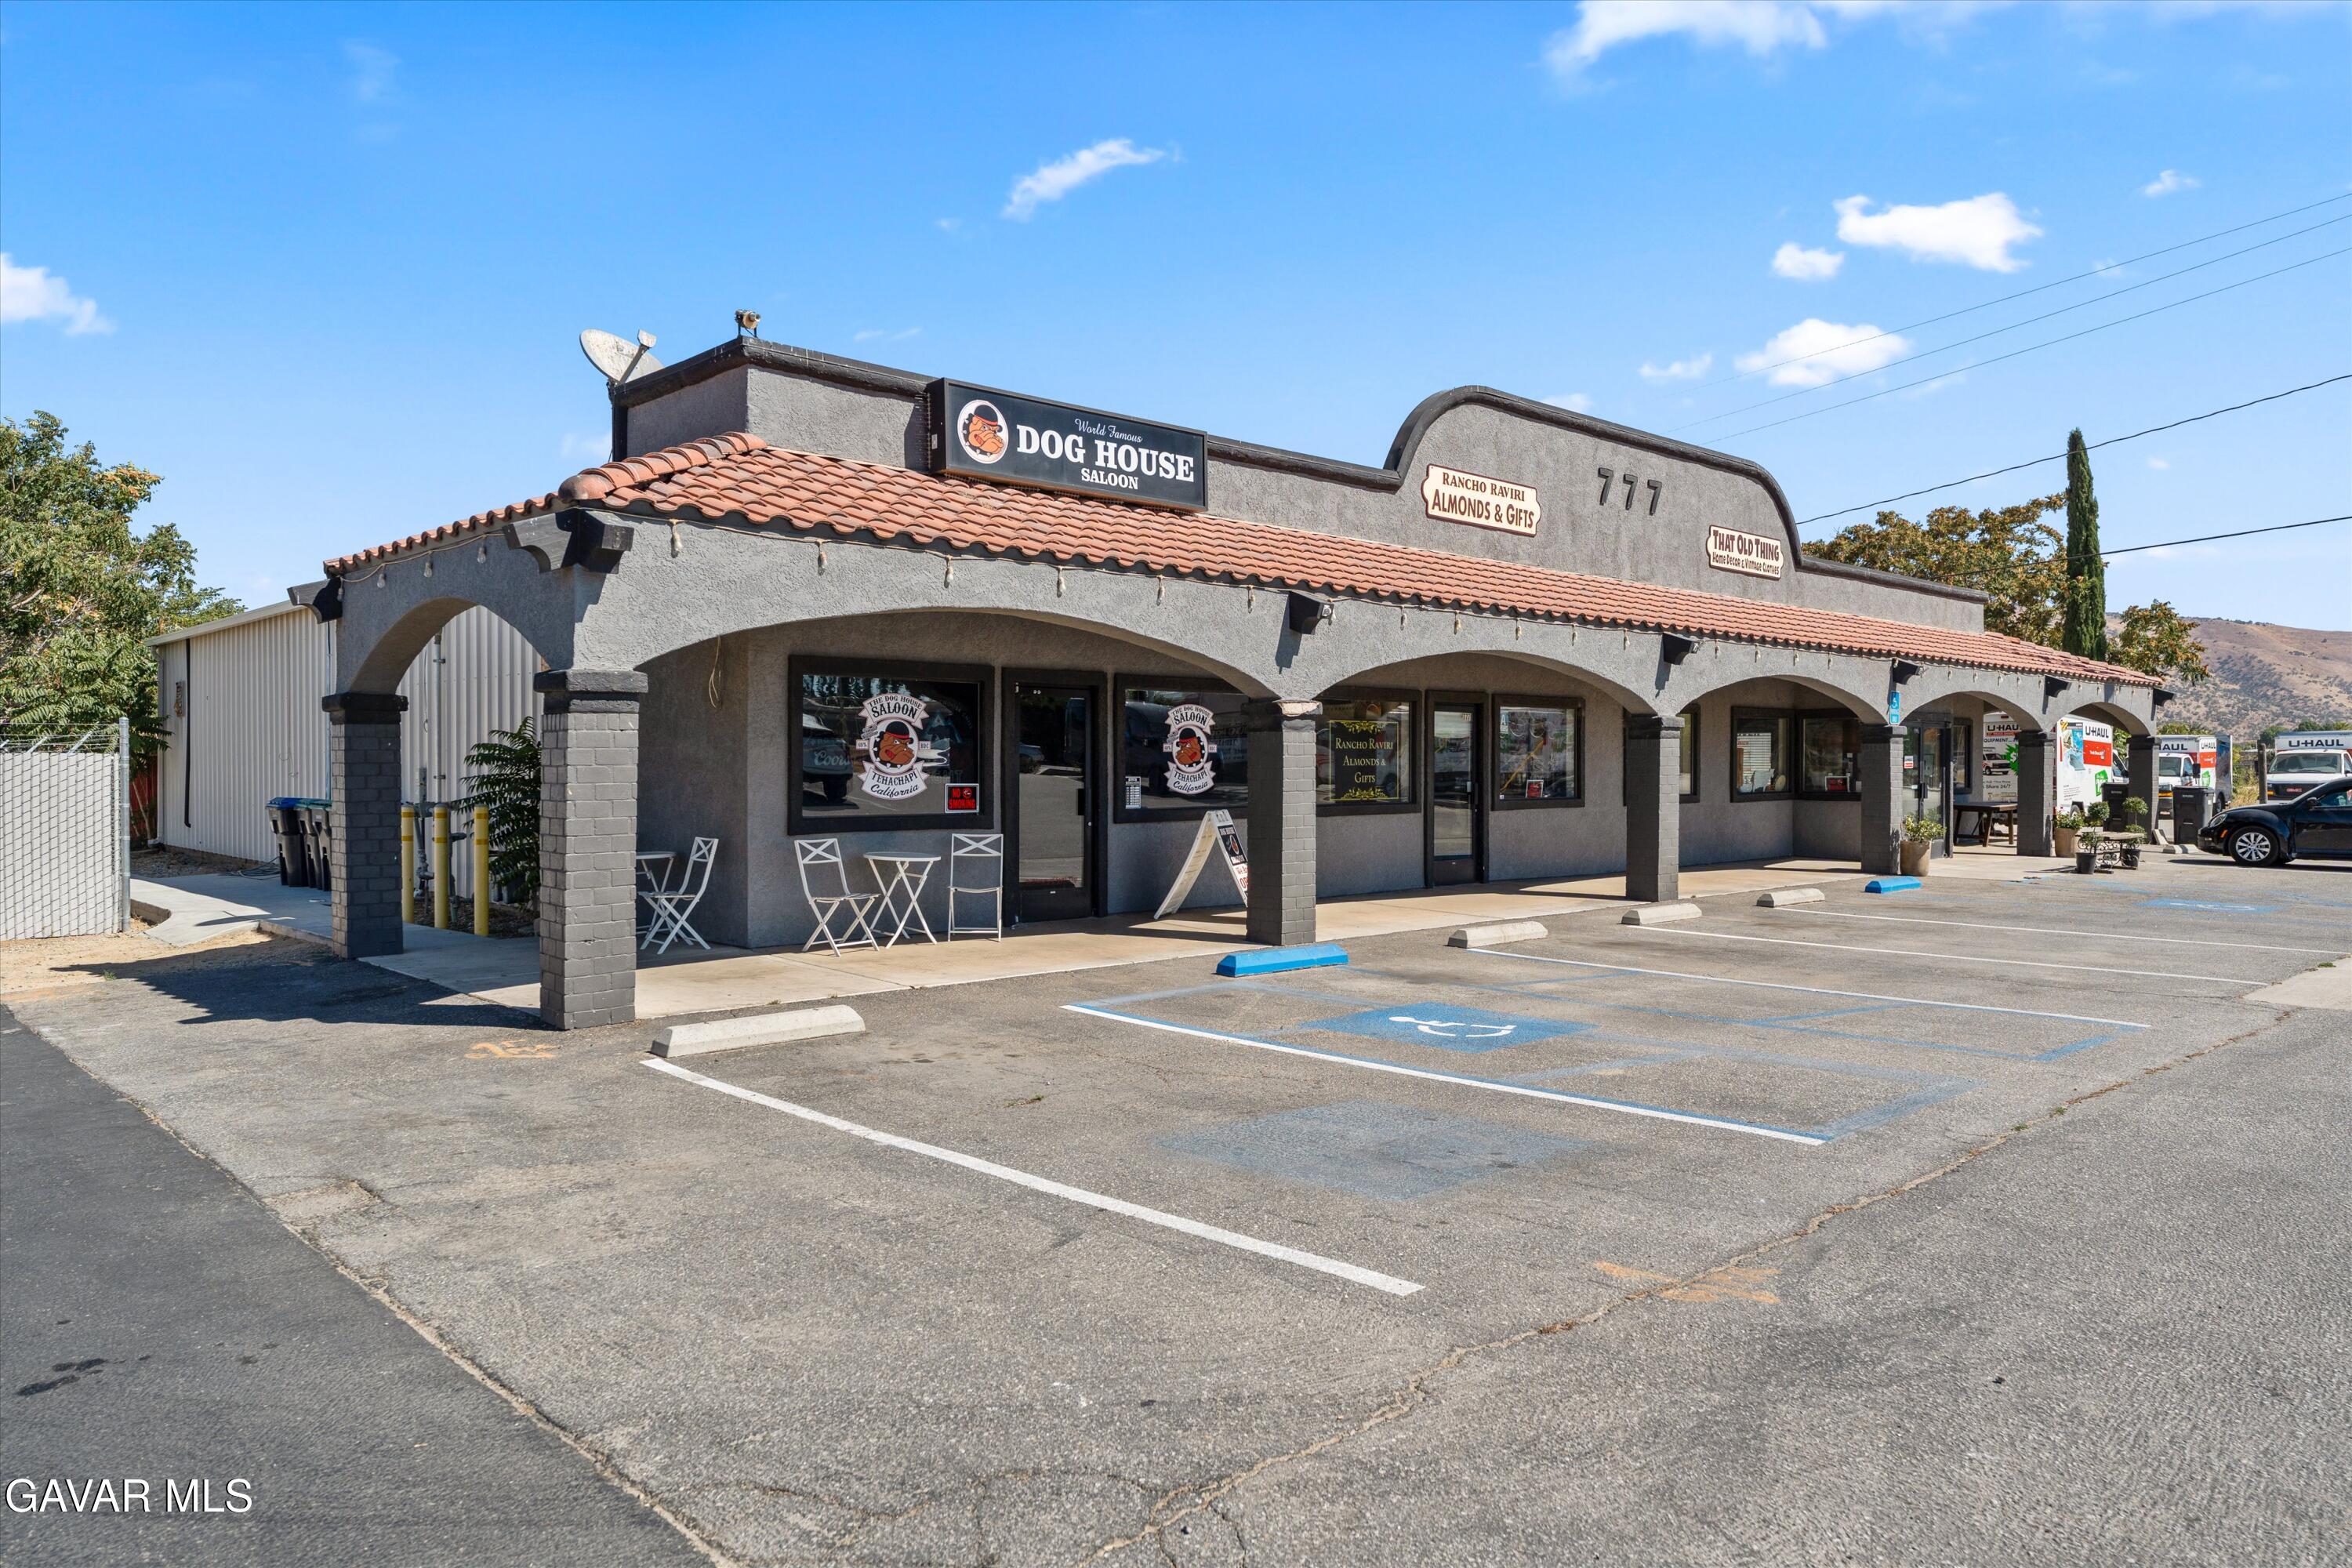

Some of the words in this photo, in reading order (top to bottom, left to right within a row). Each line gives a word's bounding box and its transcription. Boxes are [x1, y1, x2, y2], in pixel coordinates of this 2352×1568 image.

[1075, 419, 1107, 436] World
[1108, 426, 1142, 443] Famous
[1017, 424, 1086, 464] DOG
[1094, 439, 1194, 483] HOUSE
[1081, 468, 1138, 490] SALOON
[1443, 472, 1486, 493] RANCHO
[1490, 482, 1525, 502] RAVIRI
[1598, 467, 1662, 516] 777
[1432, 488, 1490, 520] ALMONDS
[1494, 504, 1503, 523] &
[1506, 503, 1534, 528] GIFTS
[1713, 530, 1735, 552] THAT
[1737, 535, 1753, 556] OLD
[1755, 538, 1779, 561] THING
[868, 697, 883, 707] THE
[900, 696, 922, 710] HOUSE
[871, 702, 918, 719] SALOON
[1174, 711, 1207, 726] SALOON
[2085, 726, 2109, 738] U-HAUL
[1335, 738, 1367, 750] RANCHO
[1369, 738, 1393, 750] RAVIRI
[1343, 755, 1380, 766] ALMONDS
[871, 771, 918, 786] TEHACHAPI
[1174, 770, 1207, 782] TEHACHAPI
[1354, 772, 1376, 782] GIFTS
[870, 784, 919, 798] California
[952, 787, 960, 798] NO
[1173, 781, 1208, 792] California
[949, 798, 975, 809] SMOKING
